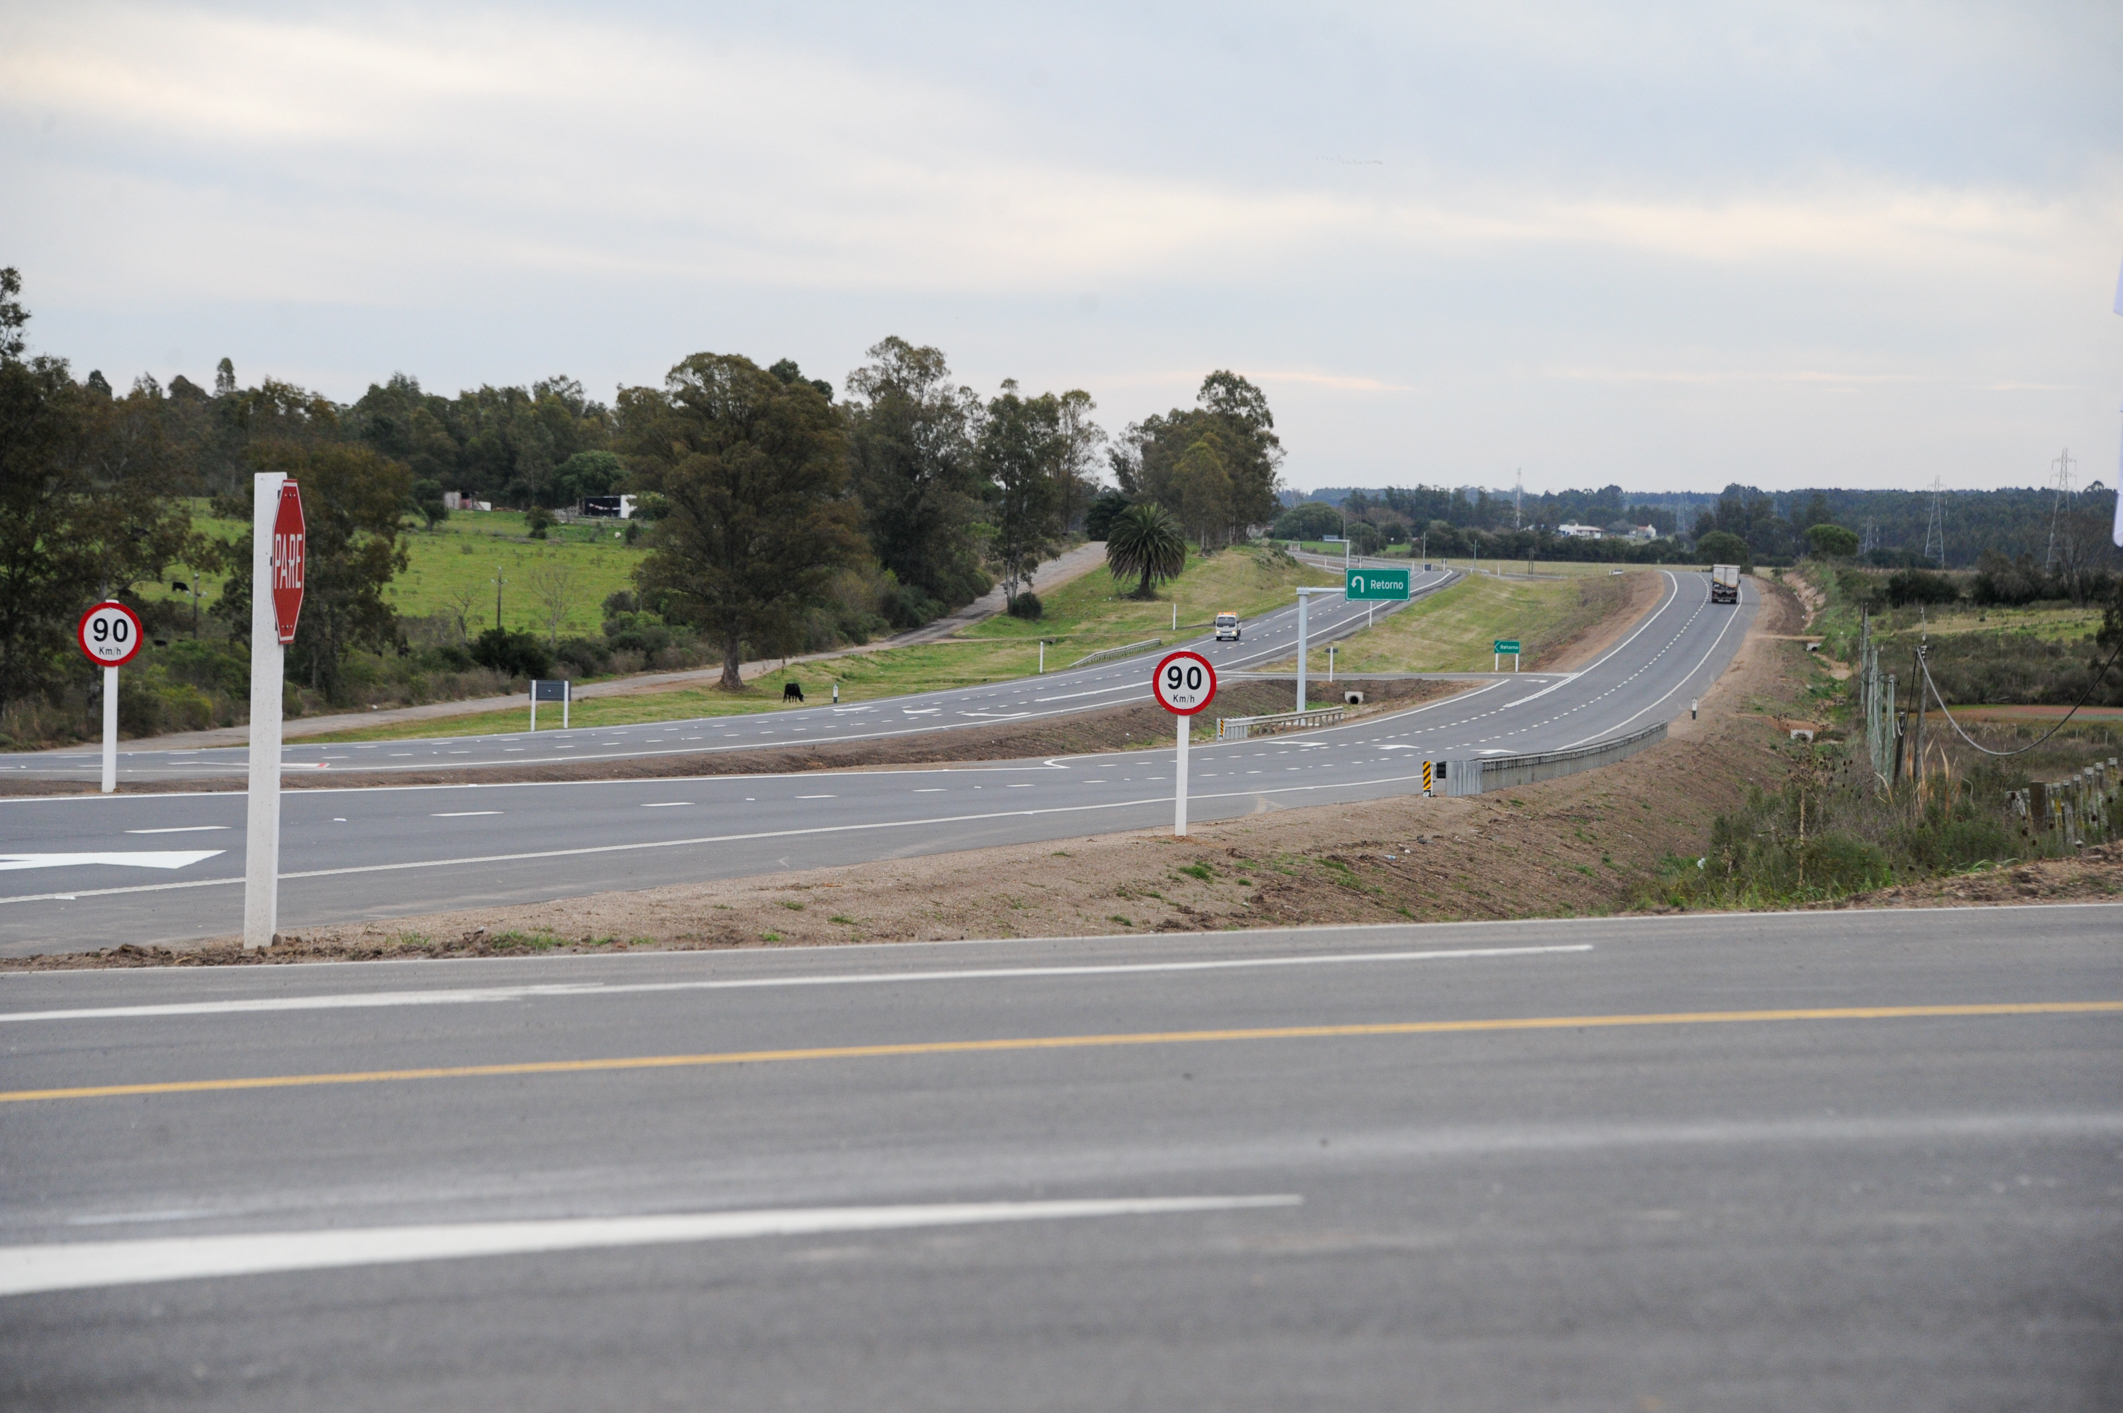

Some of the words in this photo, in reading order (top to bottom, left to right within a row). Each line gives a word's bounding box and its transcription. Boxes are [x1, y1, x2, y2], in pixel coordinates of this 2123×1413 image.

[274, 533, 303, 589] PARE
[1370, 579, 1404, 590] Retorno
[93, 617, 128, 643] 90
[98, 646, 122, 656] Km/h
[1167, 665, 1202, 690] 90
[1172, 694, 1195, 704] Km/h
